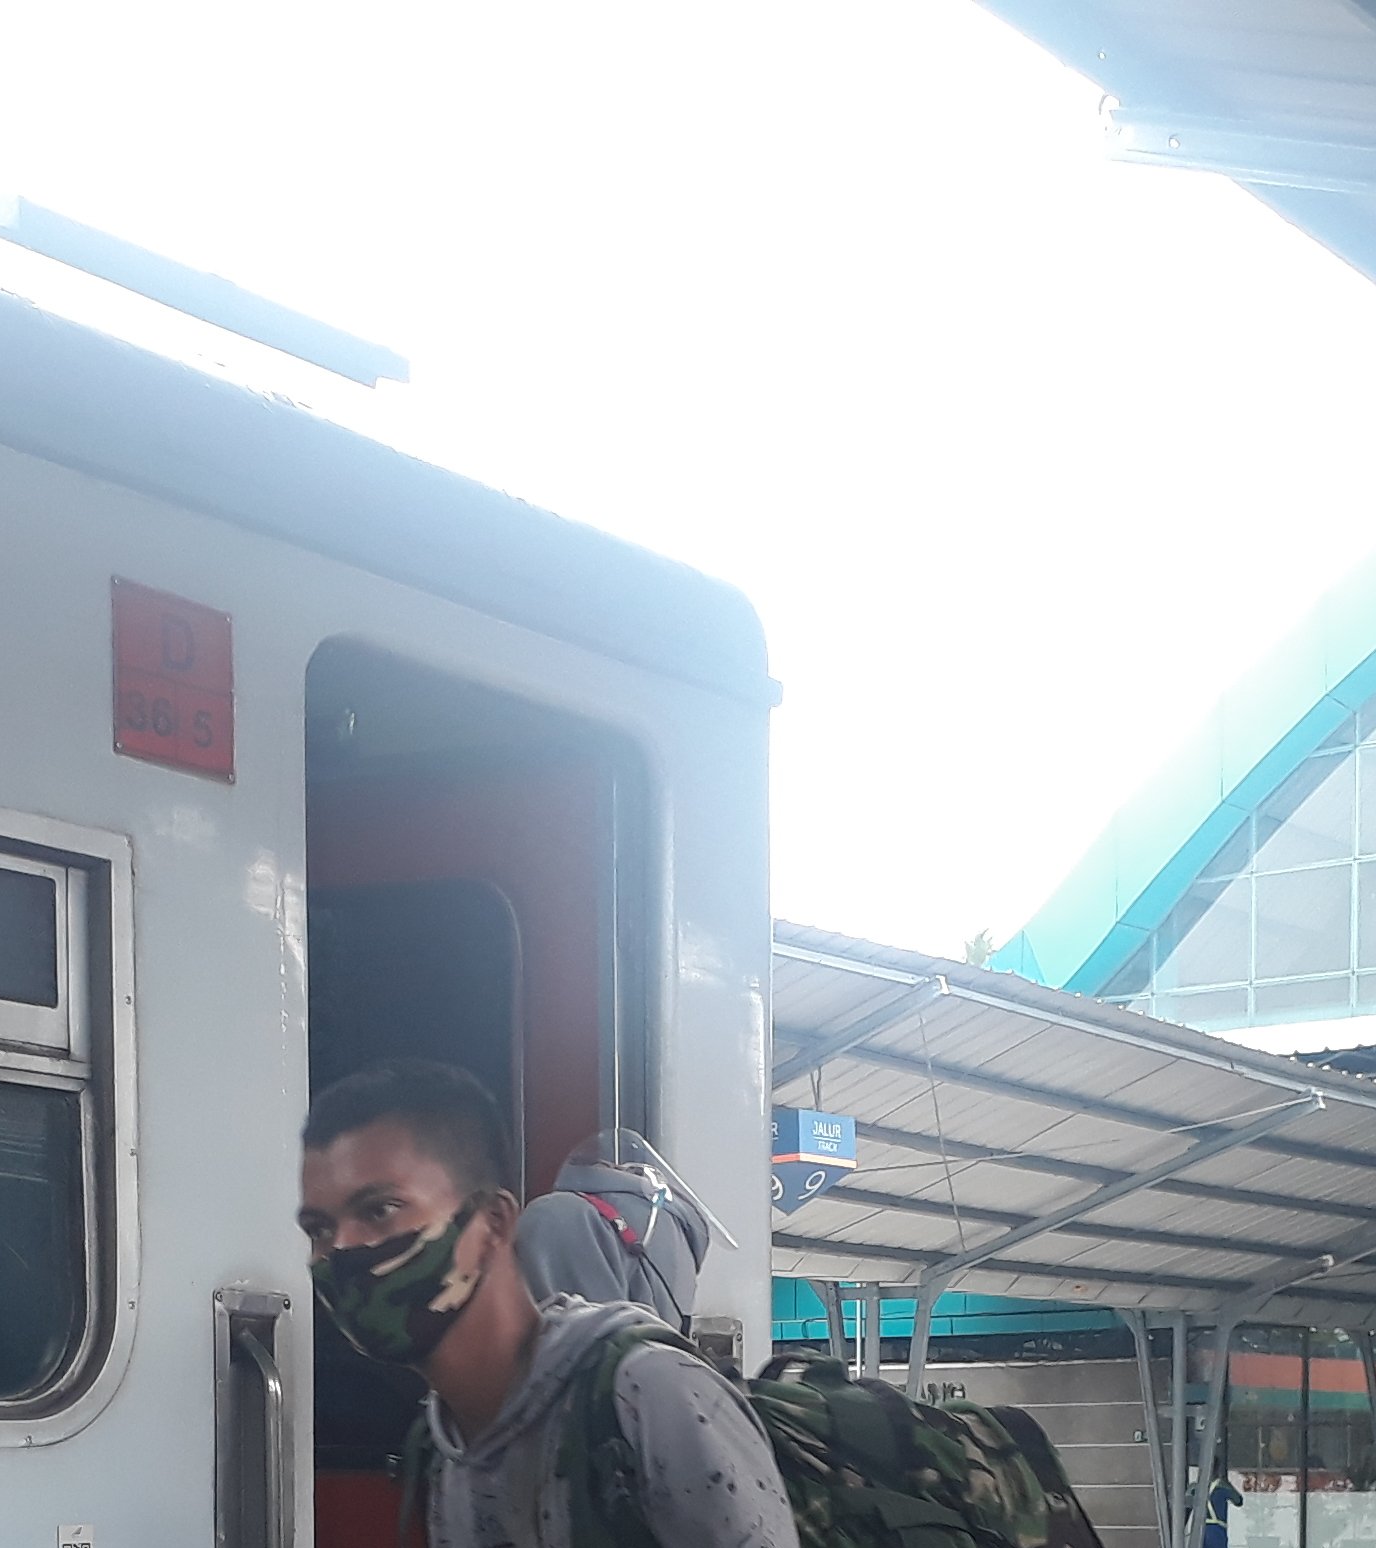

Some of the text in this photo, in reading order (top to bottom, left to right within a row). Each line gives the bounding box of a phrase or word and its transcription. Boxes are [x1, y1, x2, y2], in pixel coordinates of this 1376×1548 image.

[160, 614, 195, 673] D
[812, 1120, 842, 1138] JALUR
[797, 1170, 826, 1201] 9
